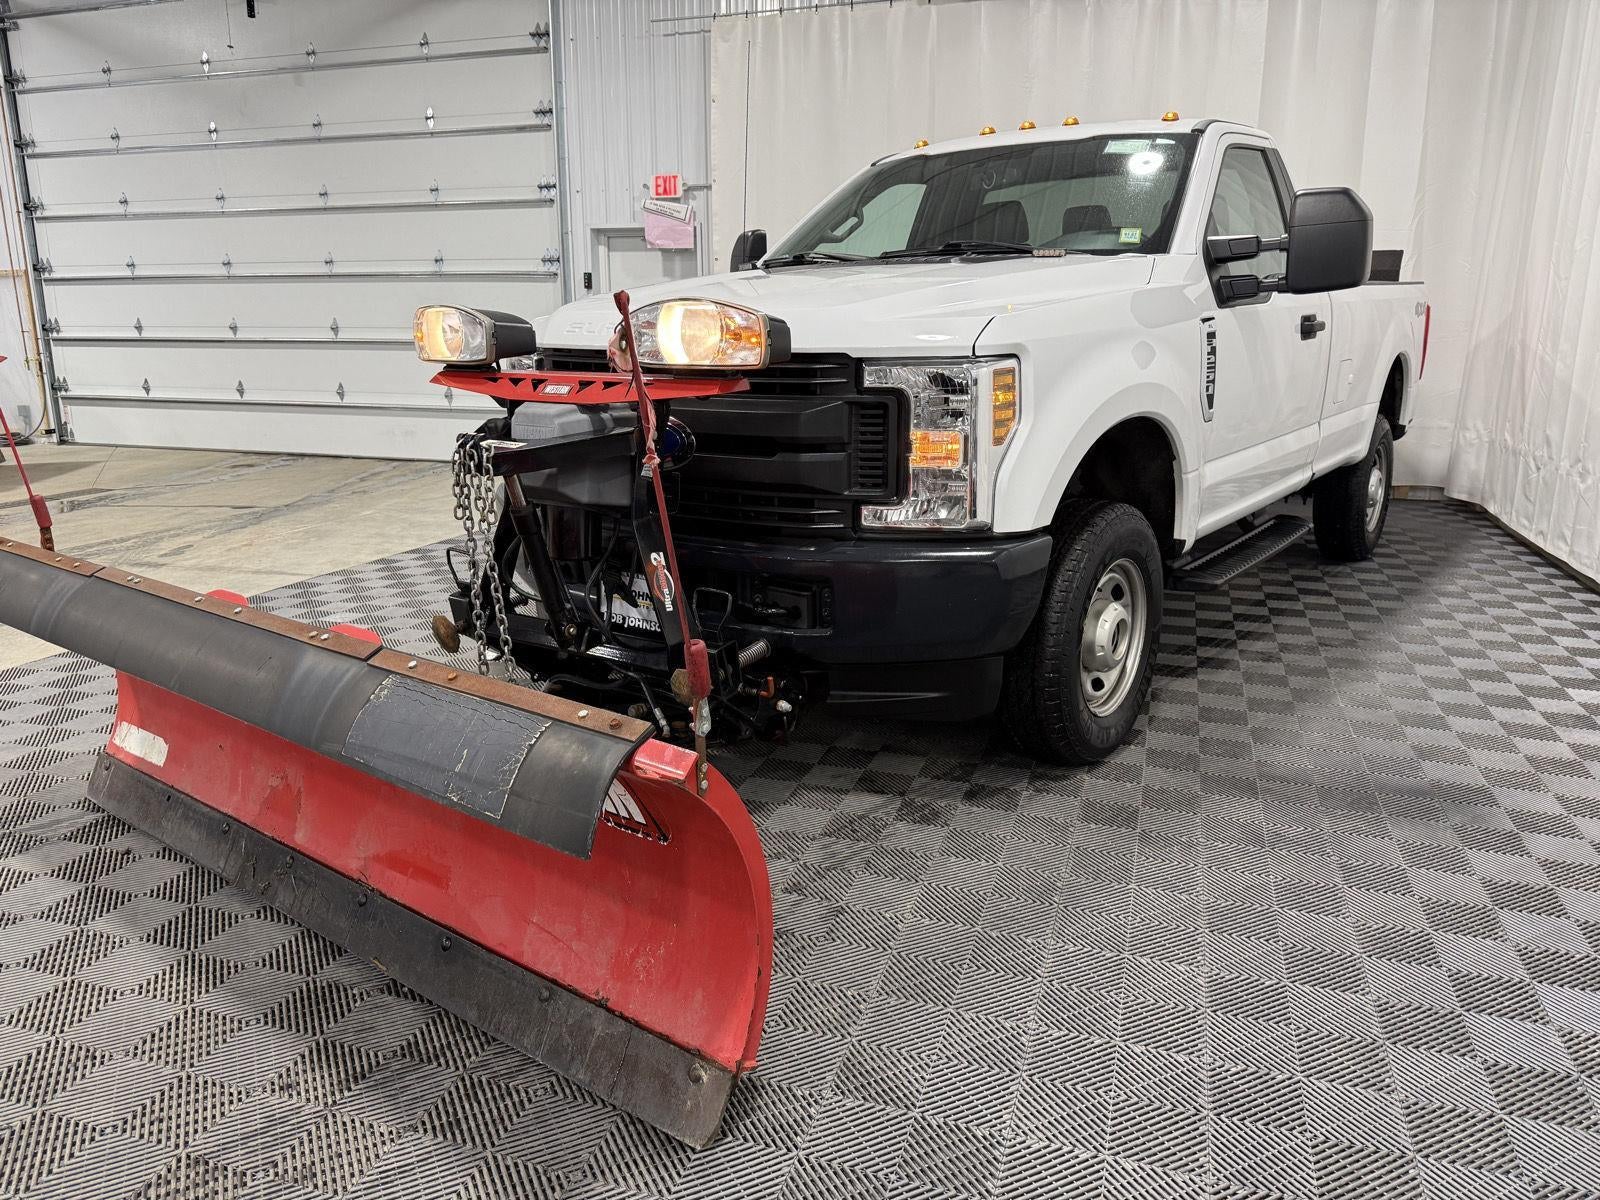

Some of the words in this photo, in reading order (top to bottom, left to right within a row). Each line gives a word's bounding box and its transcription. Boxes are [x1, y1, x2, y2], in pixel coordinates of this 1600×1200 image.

[655, 175, 679, 197] EXIT
[543, 384, 572, 395] WESTERN
[624, 616, 661, 632] JOHNSO
